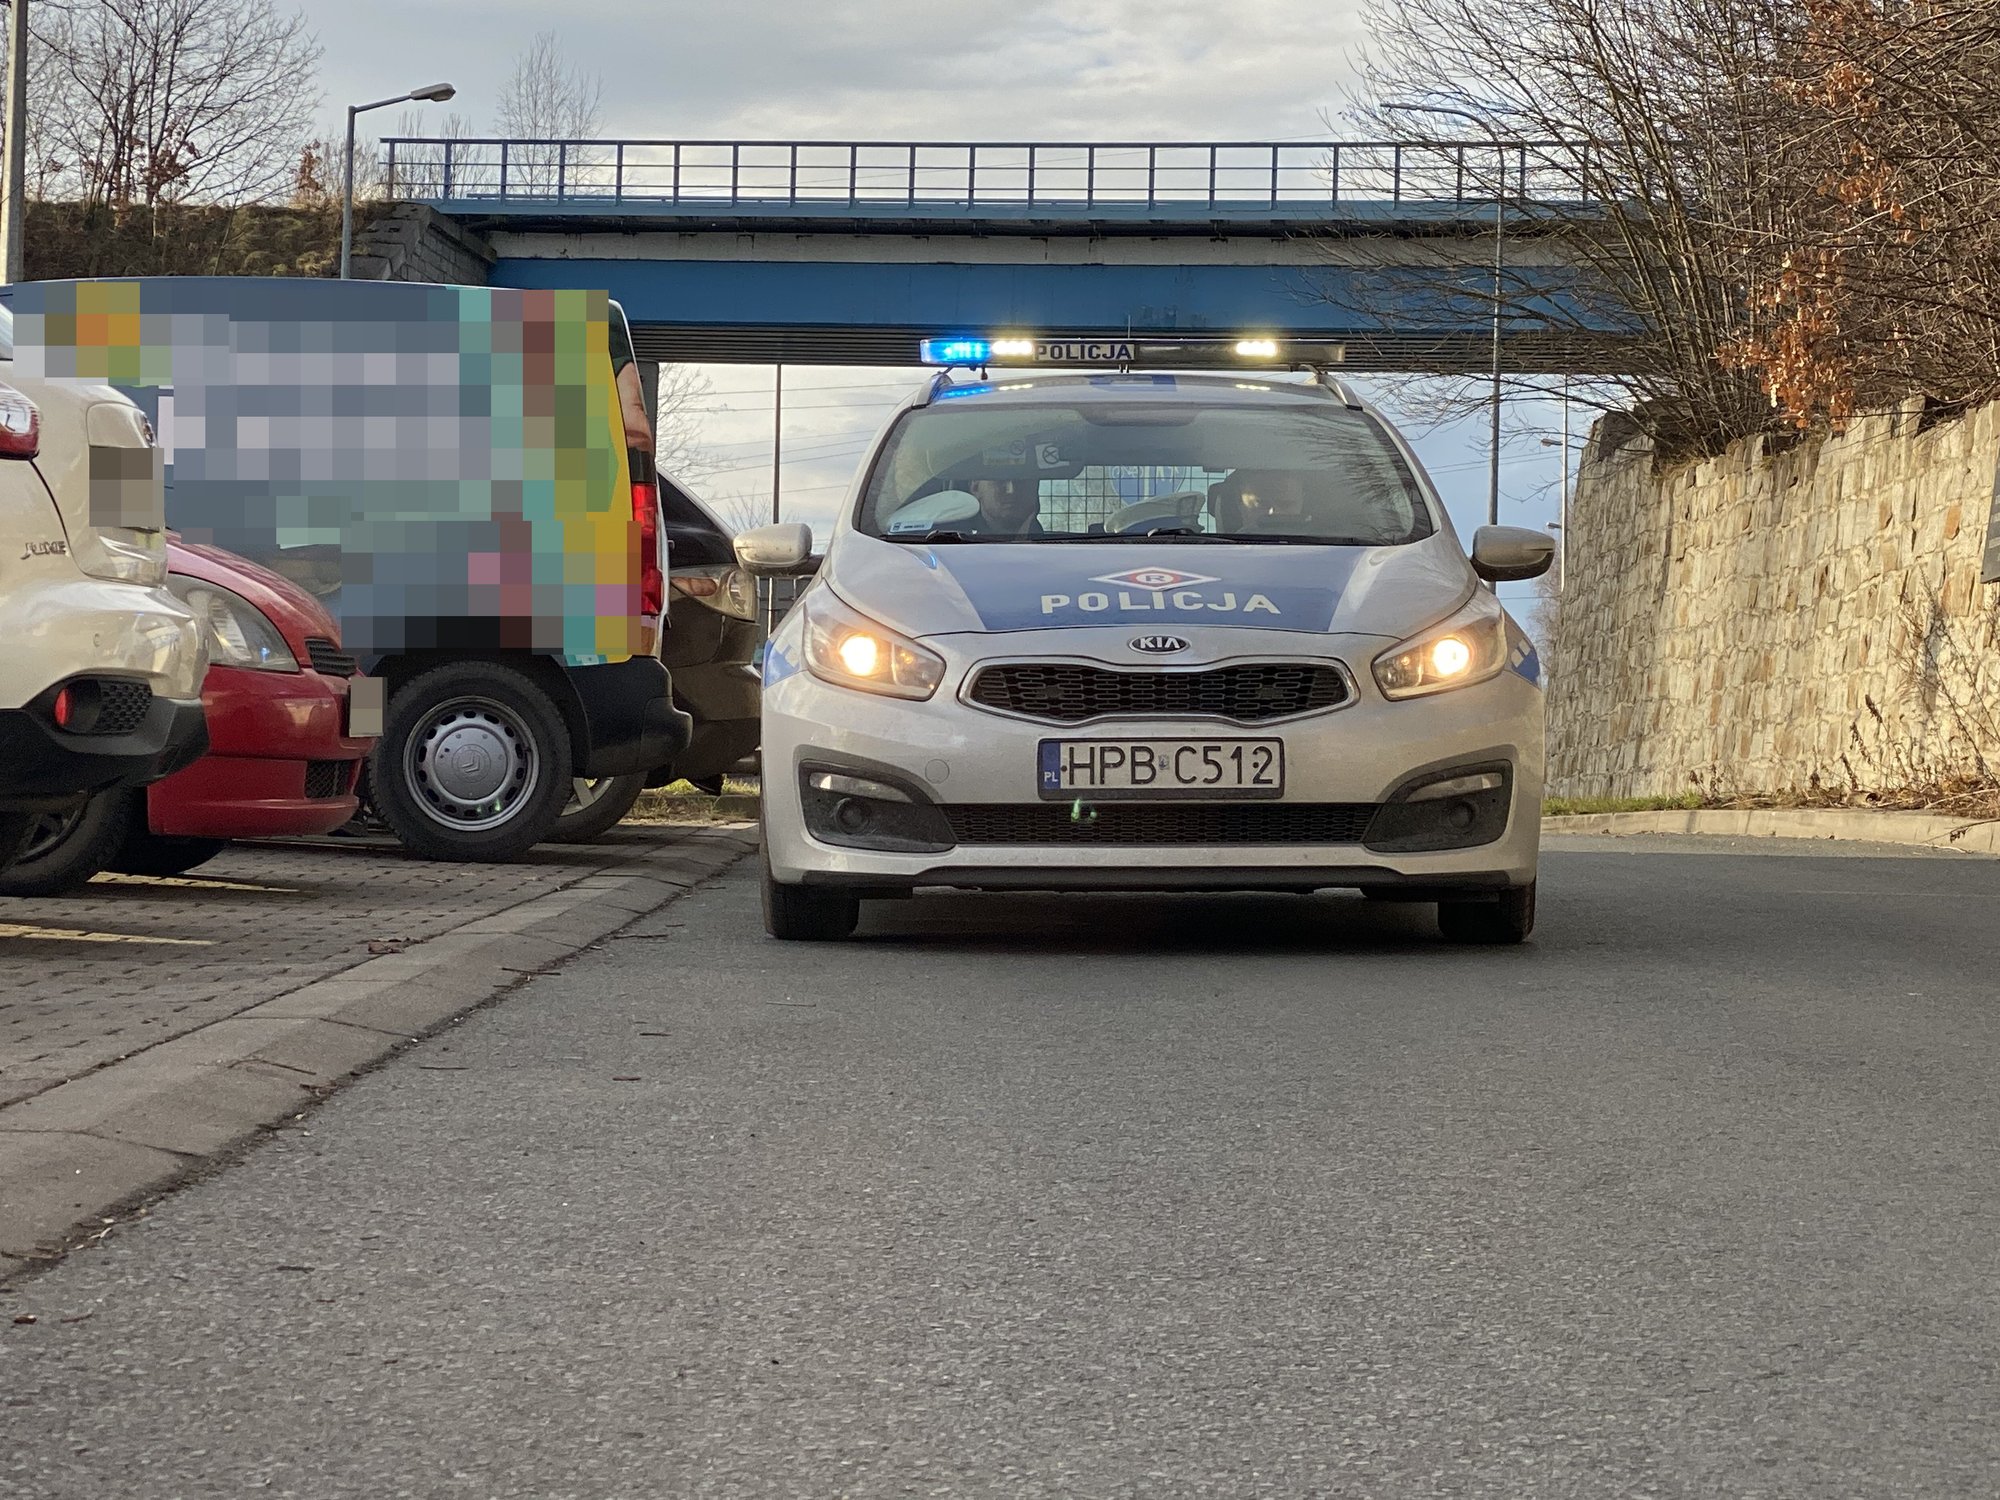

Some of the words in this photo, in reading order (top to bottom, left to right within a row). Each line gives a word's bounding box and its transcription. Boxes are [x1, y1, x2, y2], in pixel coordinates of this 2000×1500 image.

[1034, 344, 1132, 360] POLICJA
[1145, 575, 1165, 583] R
[1040, 591, 1281, 614] POLICJA
[1140, 637, 1180, 649] KIA
[1068, 745, 1157, 785] HPB
[1174, 745, 1274, 785] C512
[1044, 772, 1059, 783] PL
